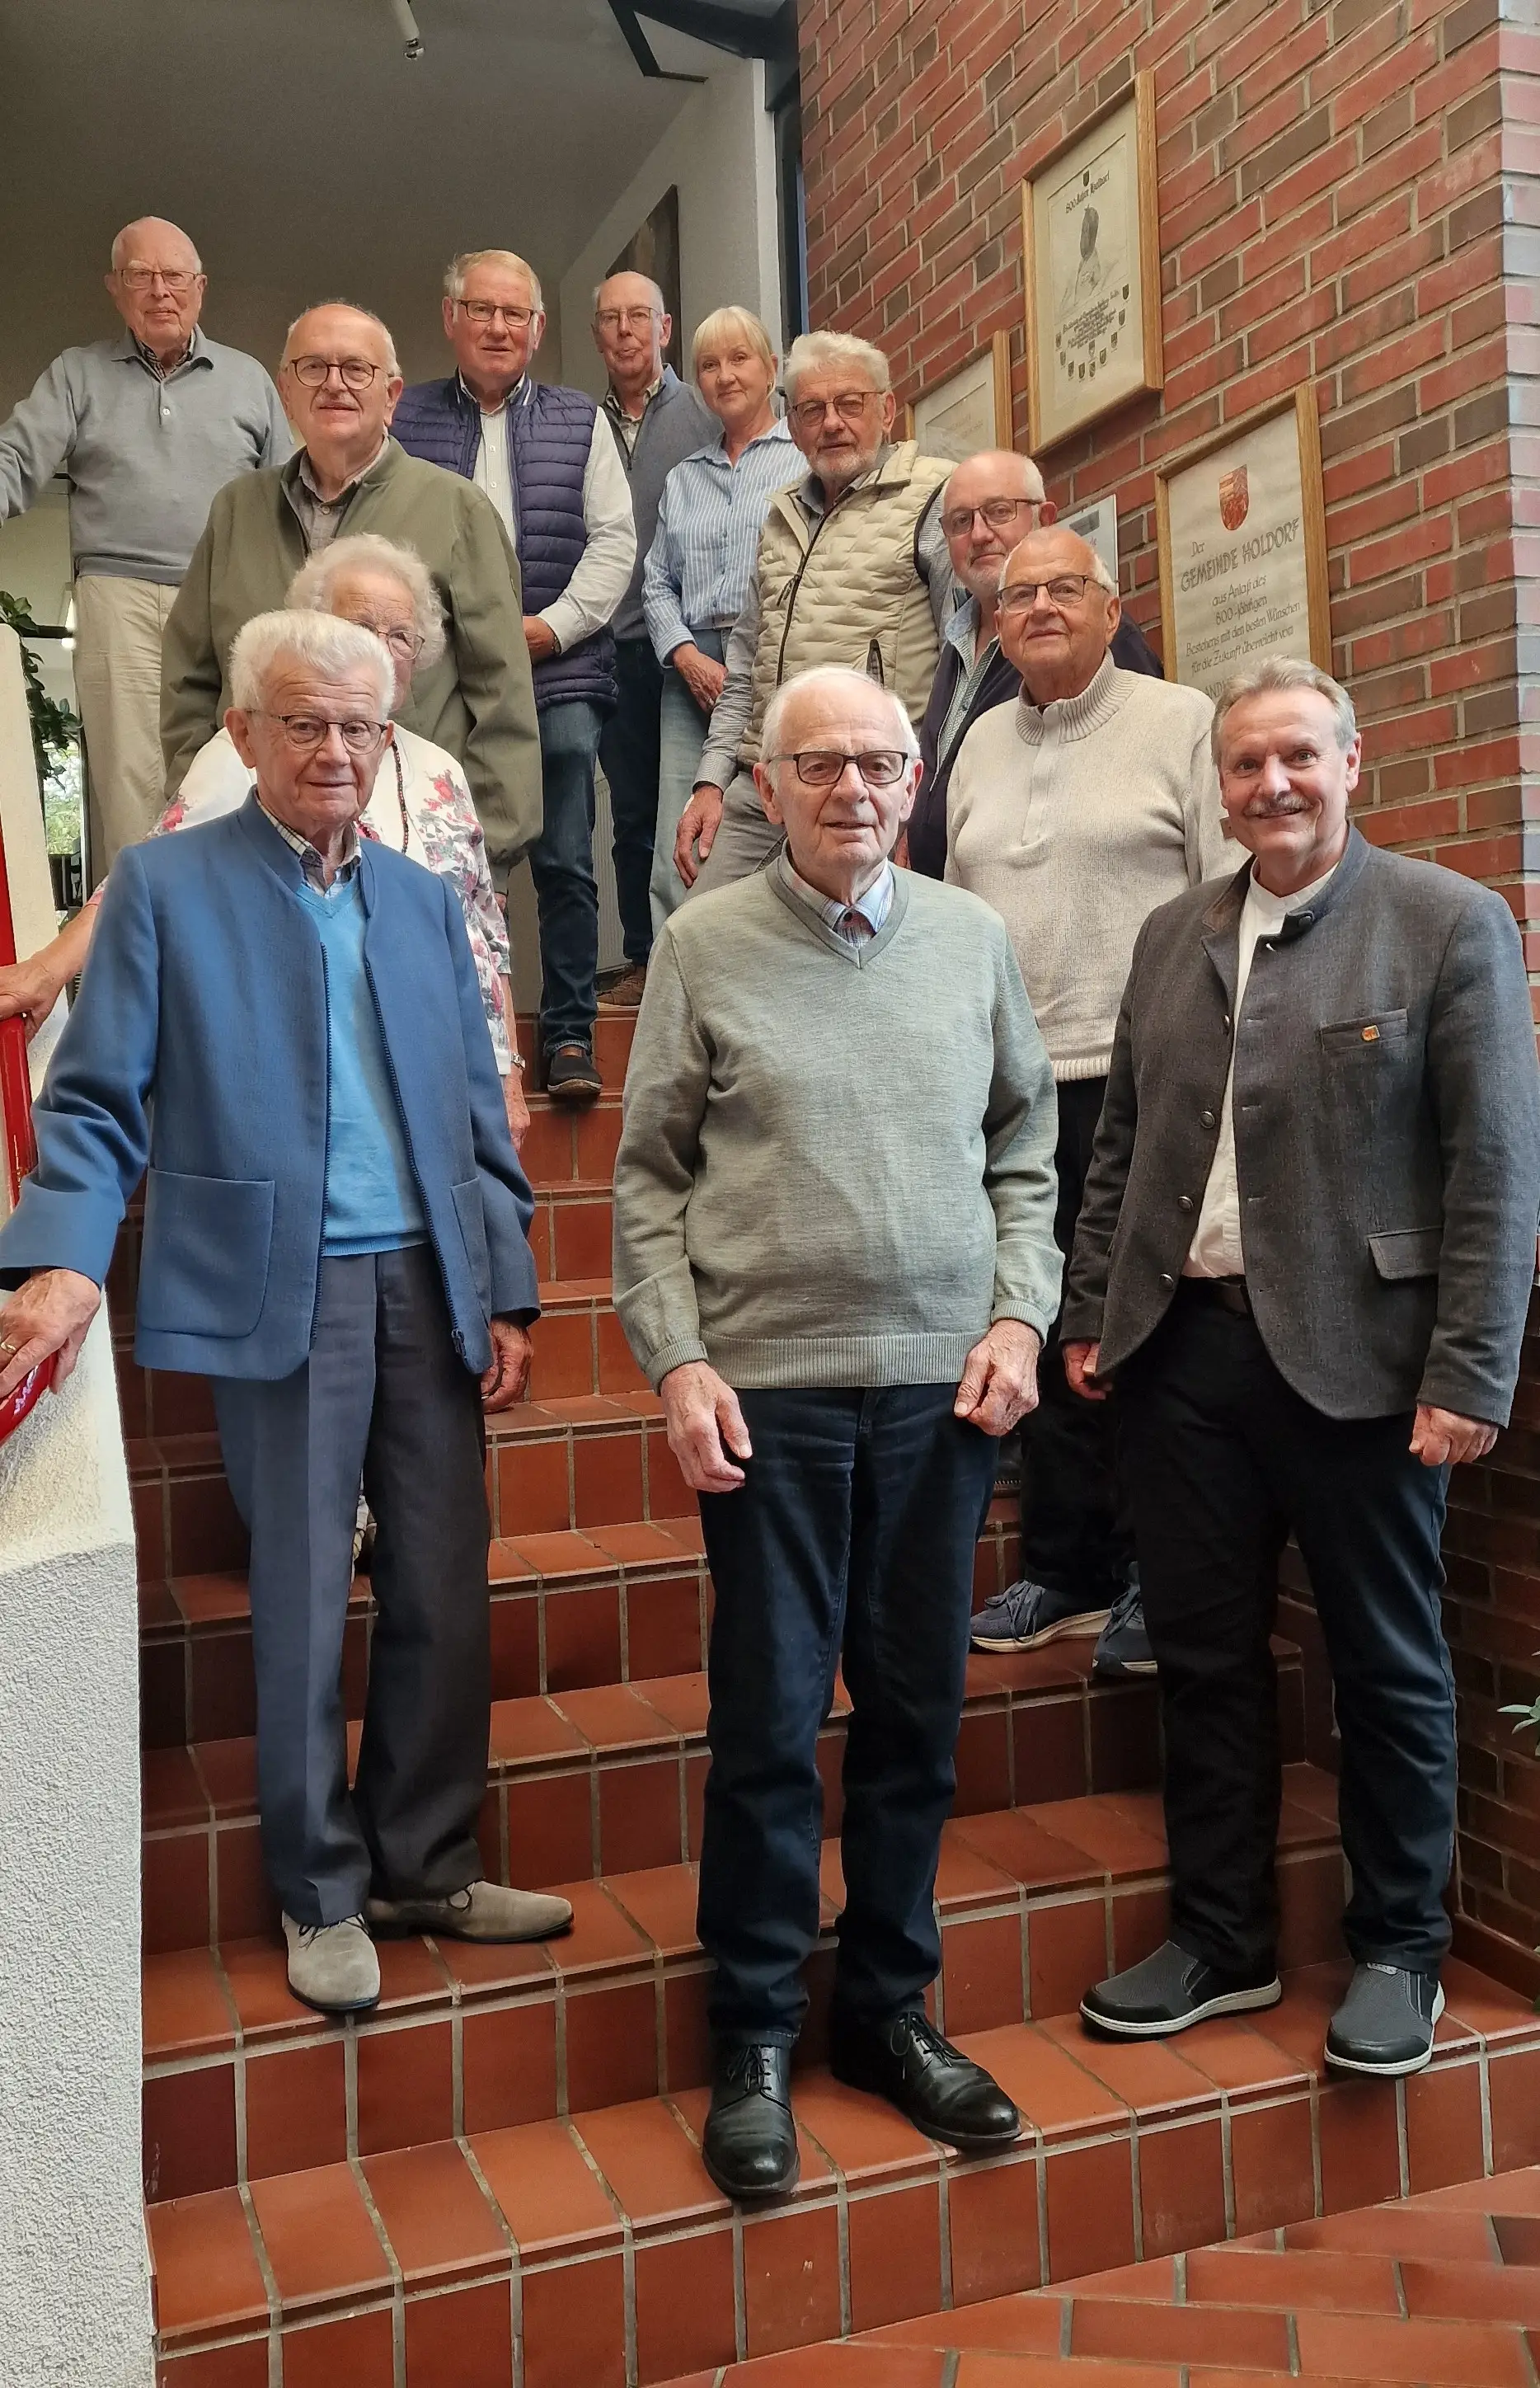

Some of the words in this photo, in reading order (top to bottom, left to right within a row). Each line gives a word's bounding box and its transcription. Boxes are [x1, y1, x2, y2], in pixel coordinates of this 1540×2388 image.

[1181, 548, 1238, 592] GEMEINDE
[1242, 517, 1299, 564] HOLDORF
[1191, 541, 1205, 557] Der
[1212, 592, 1227, 606] aus
[1253, 576, 1266, 590] des
[1186, 635, 1219, 657] Bestehens
[1221, 629, 1230, 642] mit
[1232, 623, 1244, 638] den
[1246, 615, 1266, 633] besten
[1266, 602, 1301, 623] Wünschen
[1191, 660, 1202, 677] für
[1202, 656, 1212, 670] die
[1214, 645, 1241, 665] Zukunft
[1242, 629, 1279, 654] überreicht
